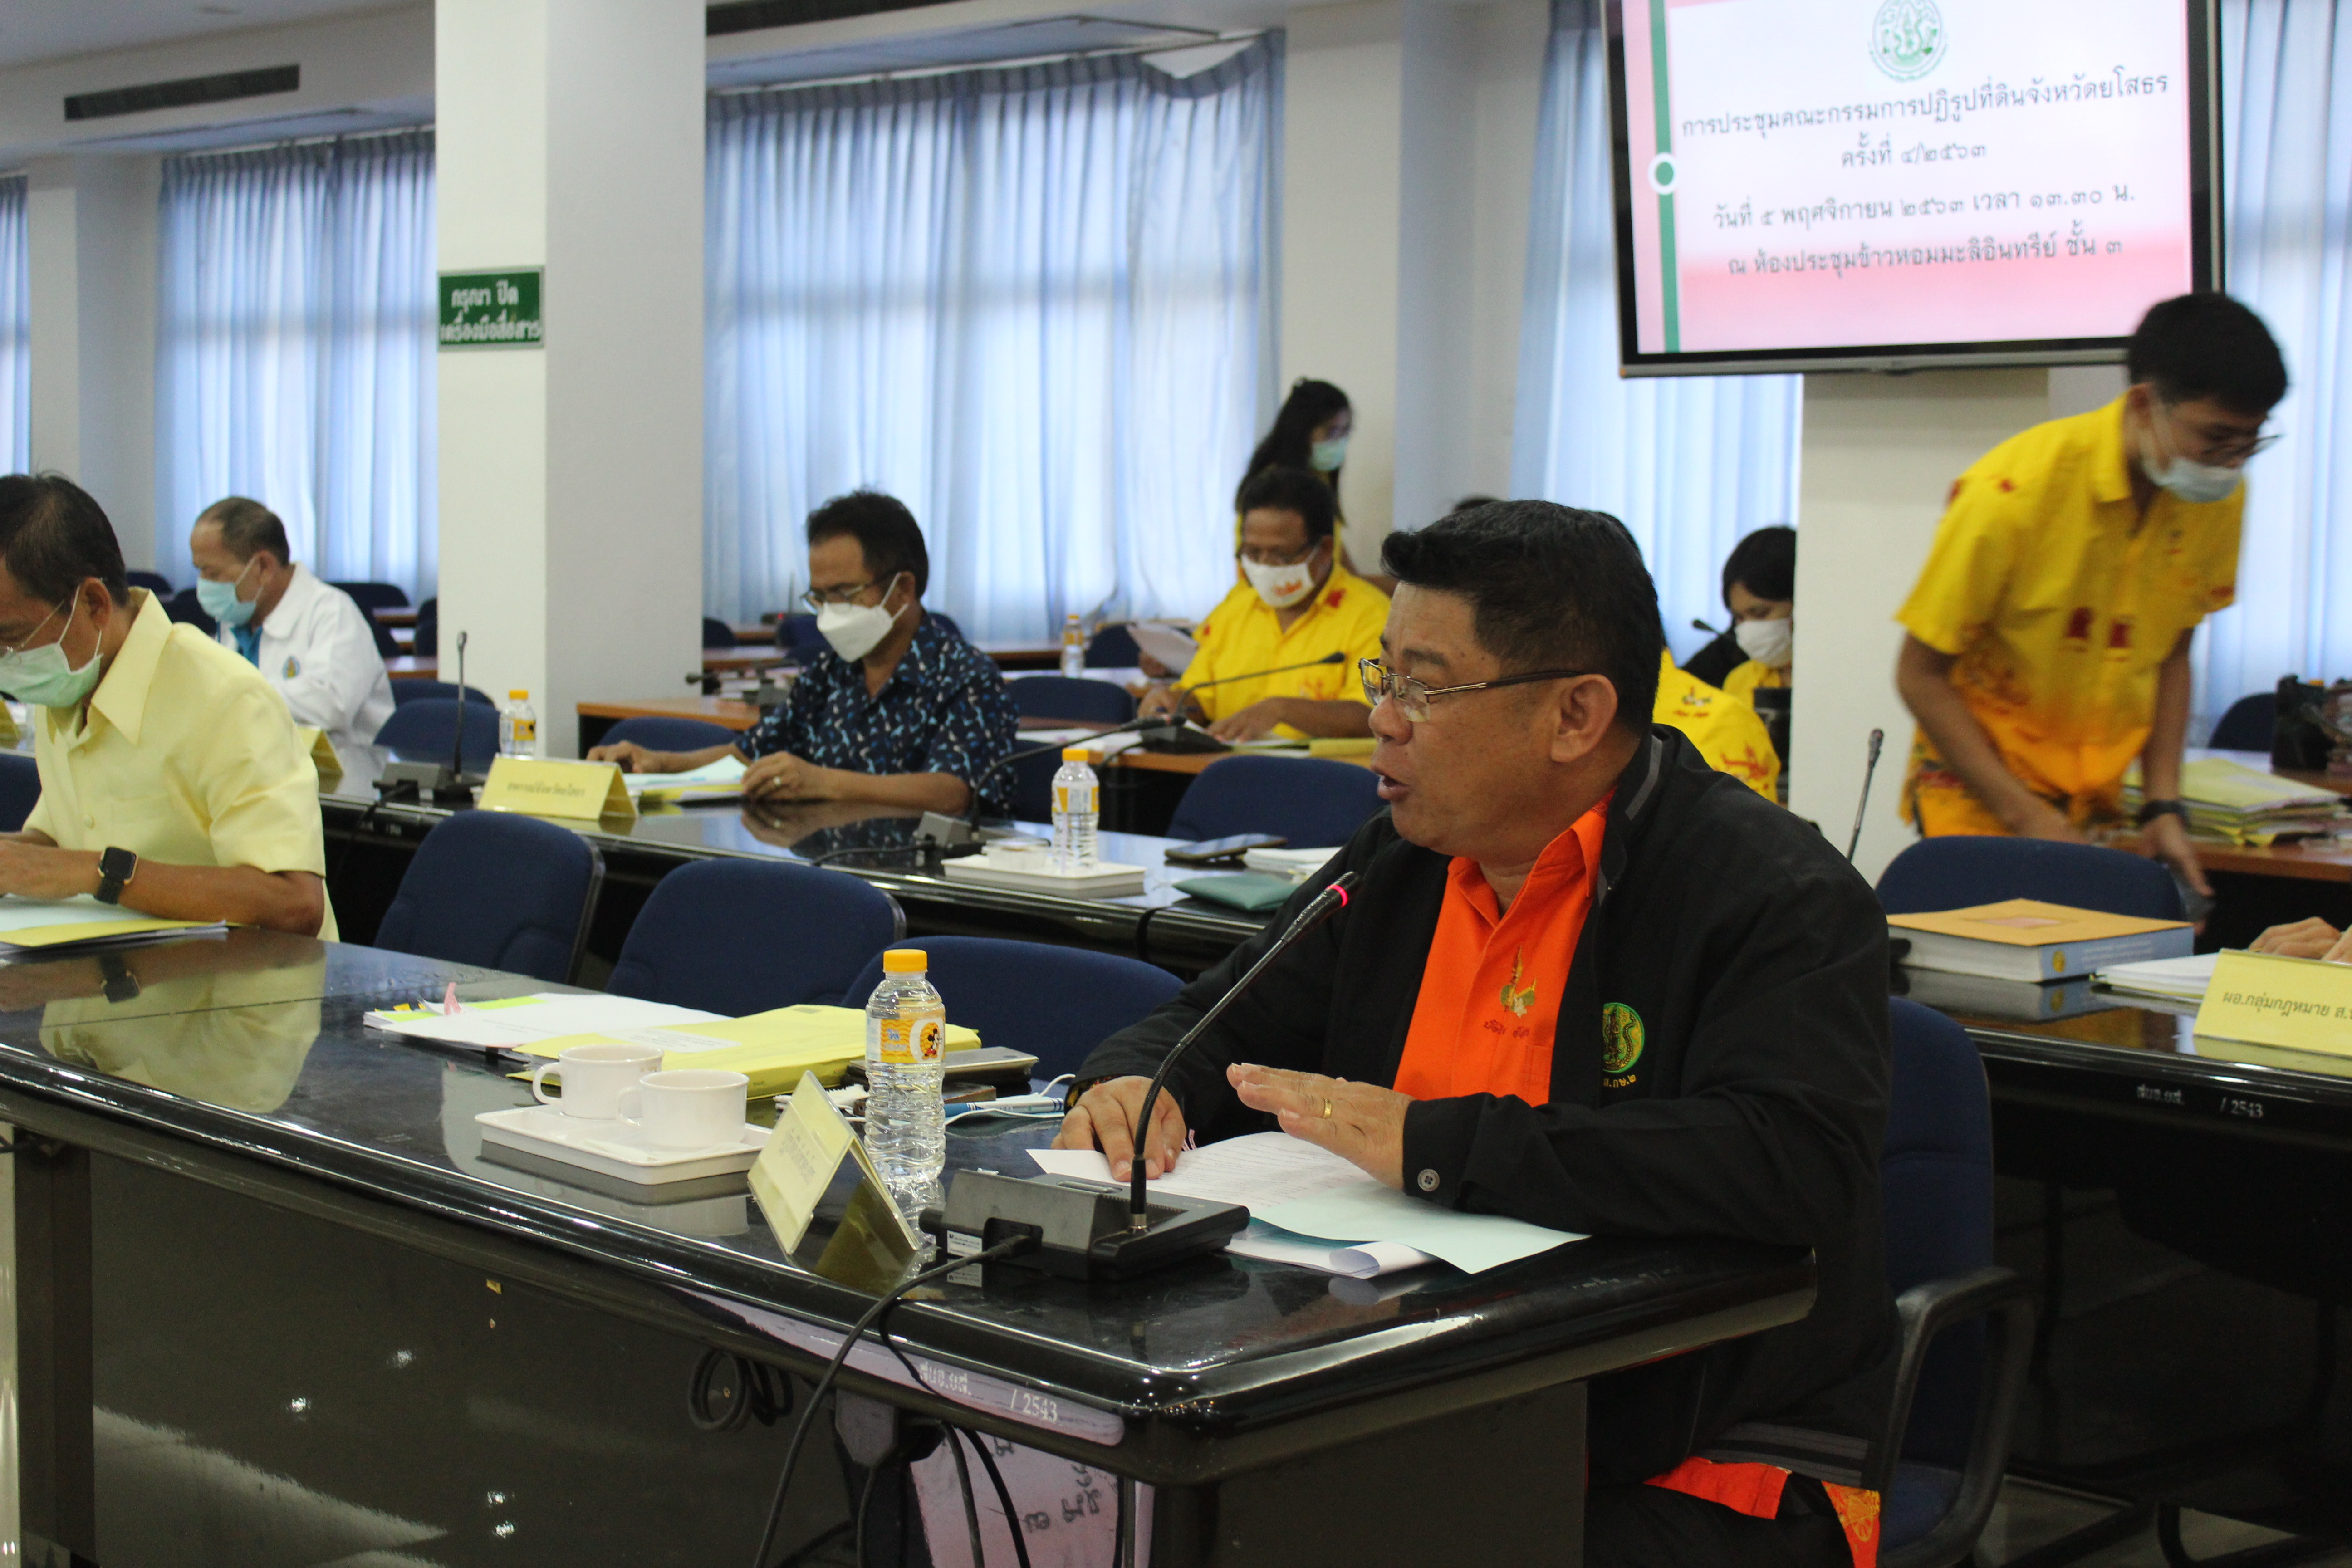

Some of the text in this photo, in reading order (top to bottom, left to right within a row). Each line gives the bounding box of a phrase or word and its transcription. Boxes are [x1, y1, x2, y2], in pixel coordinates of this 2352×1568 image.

[1681, 64, 2168, 139] การประชุมคณะกรรมการปฏิรูปที่ดินจังหวัดยโสธร
[1842, 131, 1986, 167] ครั้งที่ ๔/๒๕๖๓
[1714, 184, 2135, 230] วันที่ ๕ พฤศจิกายน ๒๕๖๓ เวลา ๑๓.๓๐ น.
[1728, 219, 2123, 279] ณ ห้องประชุมข้าวหอมมะลิอินทรีย์ ชั้น ๓
[451, 279, 519, 313] กรุณา ปิด
[440, 309, 543, 342] เครื่องมือสื่อสาร
[2222, 991, 2352, 1020] ผอ.กลุ่มกฎหมาย ส.
[1022, 1392, 1058, 1425] 2543
